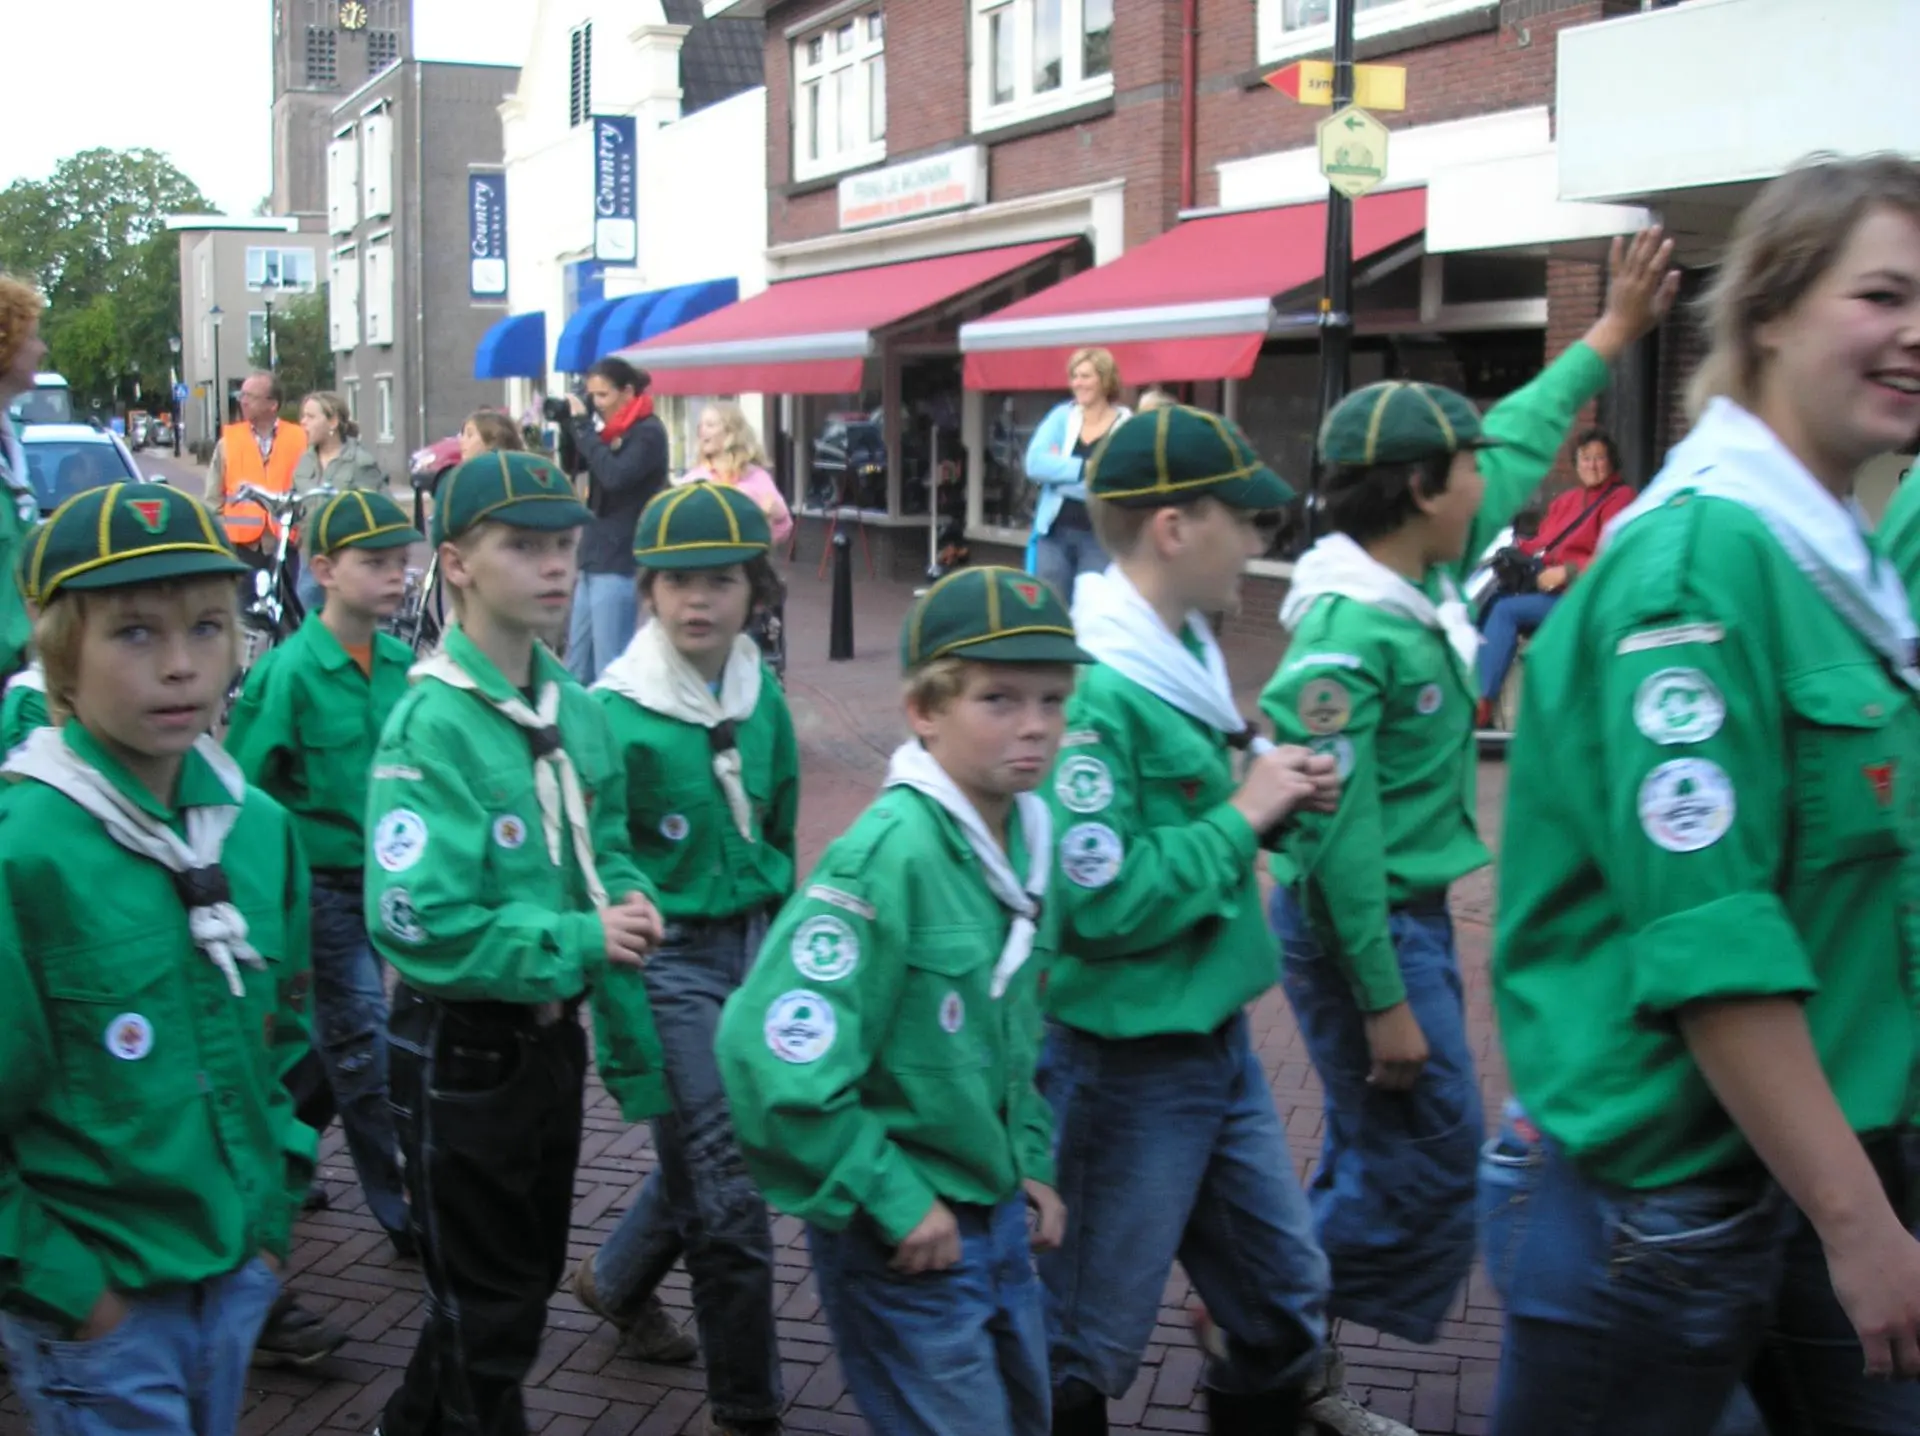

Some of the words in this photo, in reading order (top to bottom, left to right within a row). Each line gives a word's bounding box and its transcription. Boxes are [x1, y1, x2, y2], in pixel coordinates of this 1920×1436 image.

[1308, 78, 1331, 91] syn
[596, 122, 623, 216] Country
[472, 181, 495, 257] Country
